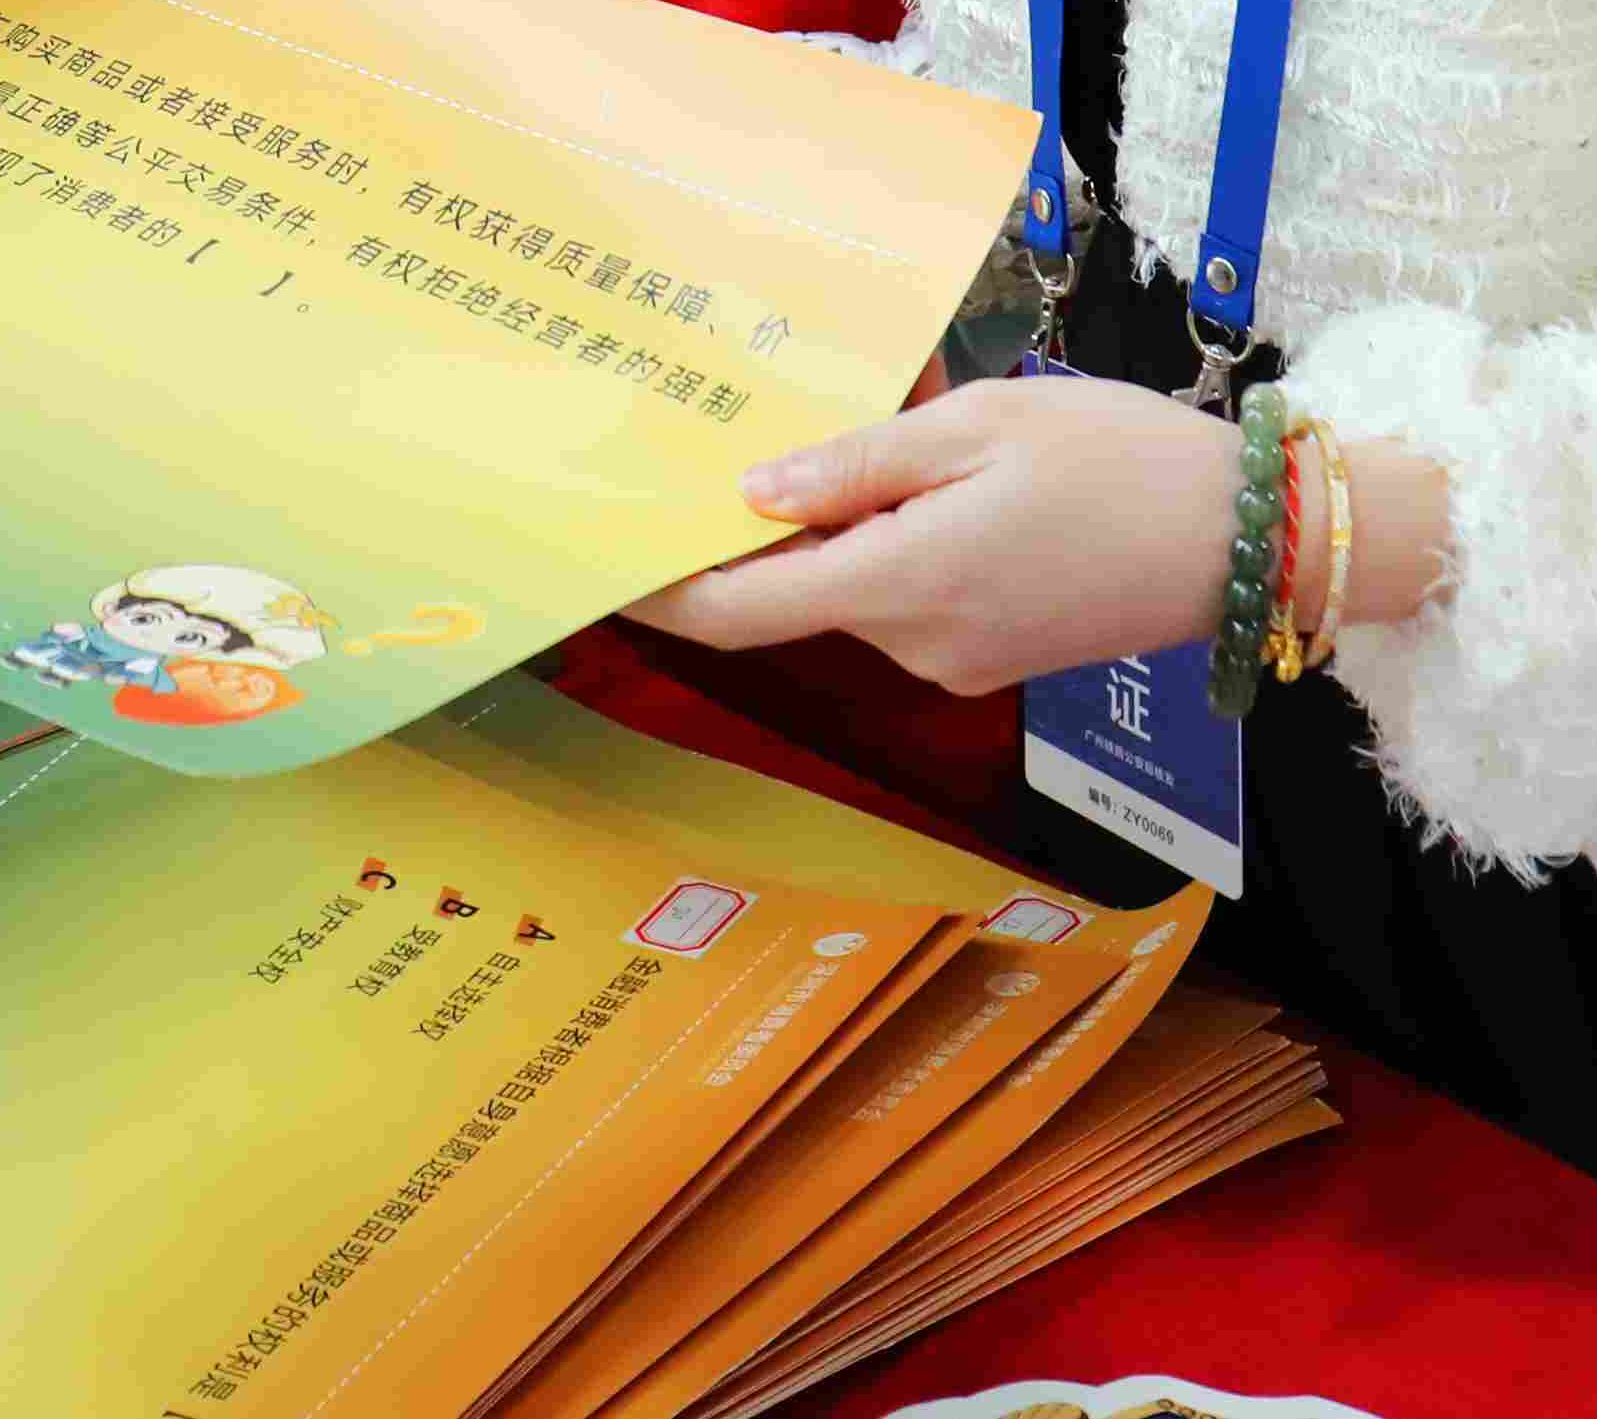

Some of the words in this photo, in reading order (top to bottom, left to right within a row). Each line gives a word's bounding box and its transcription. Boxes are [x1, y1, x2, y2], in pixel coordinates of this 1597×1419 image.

[360, 870, 397, 890] C
[439, 897, 480, 918] B
[518, 922, 556, 942] A
[408, 951, 521, 1042] 自主选择权
